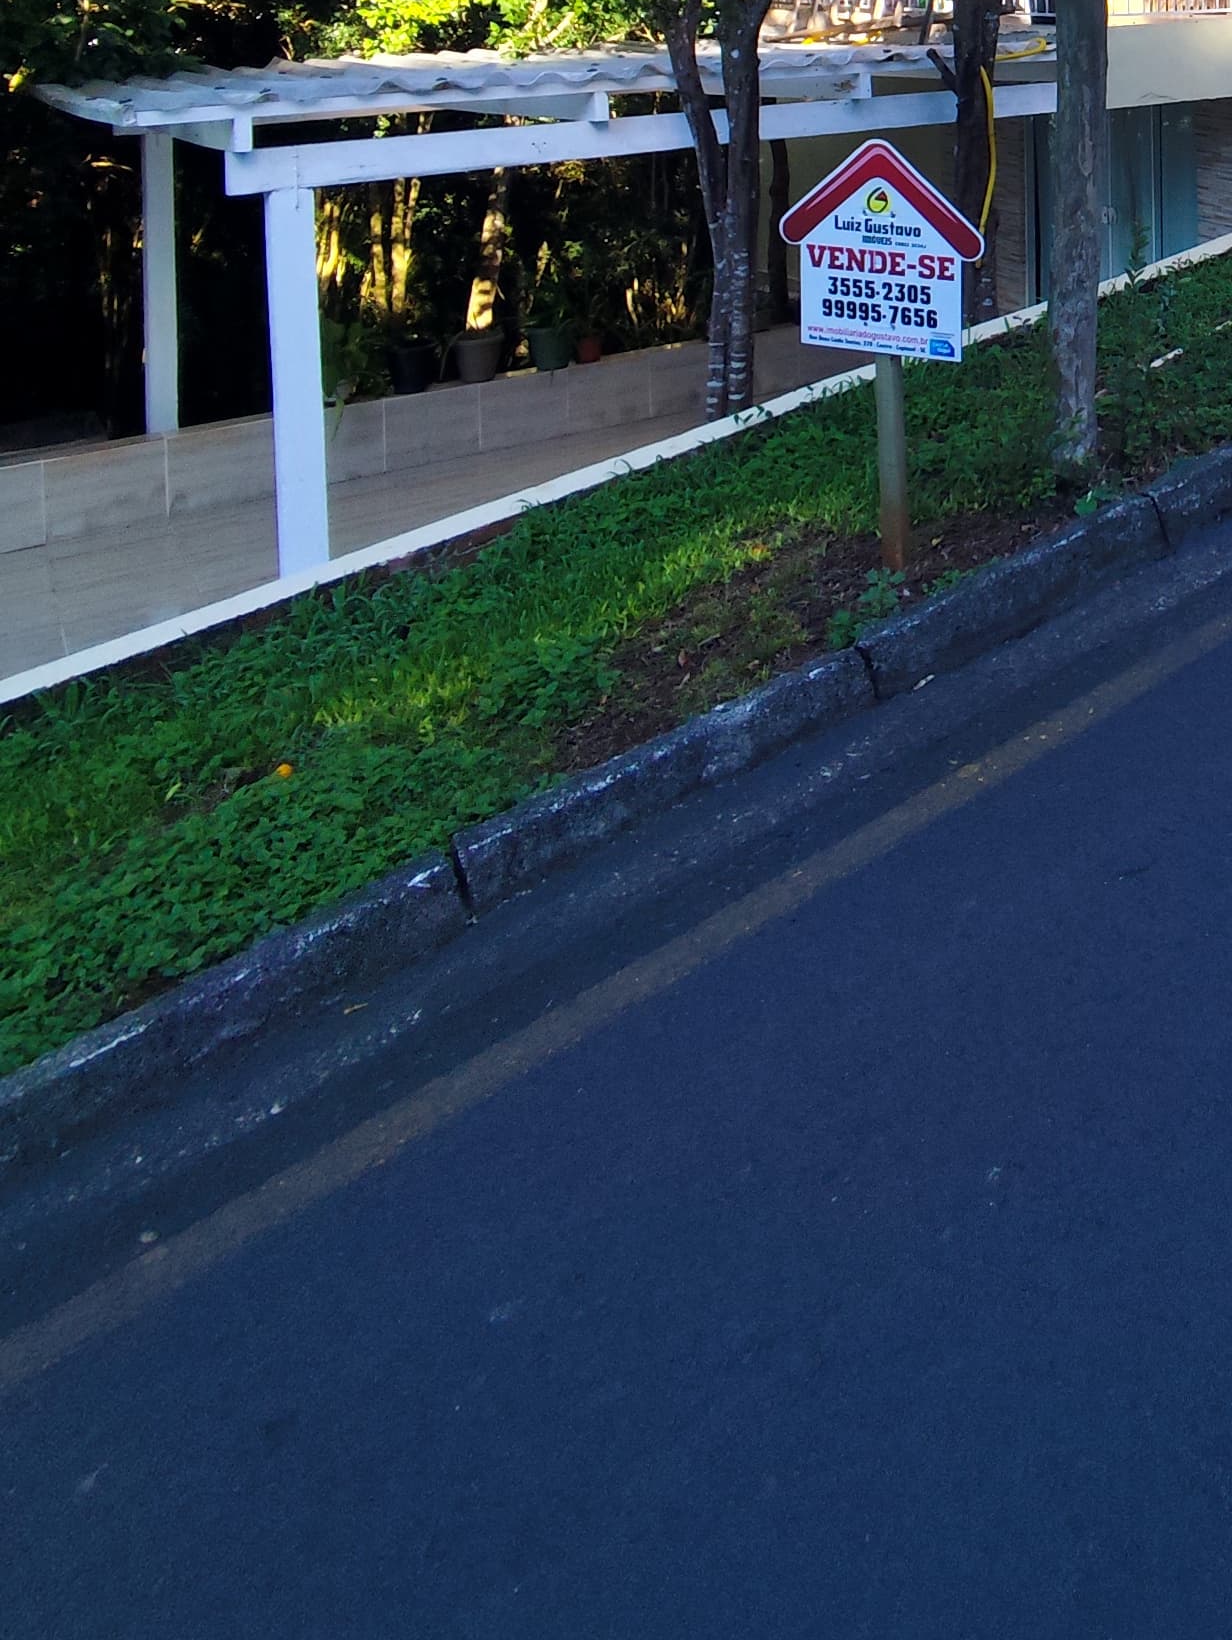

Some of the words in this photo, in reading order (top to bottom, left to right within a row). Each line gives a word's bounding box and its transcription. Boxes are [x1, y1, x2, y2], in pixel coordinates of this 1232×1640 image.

[835, 215, 862, 232] Luiz
[865, 218, 922, 238] Gustavo
[806, 244, 955, 281] VENDE-SE
